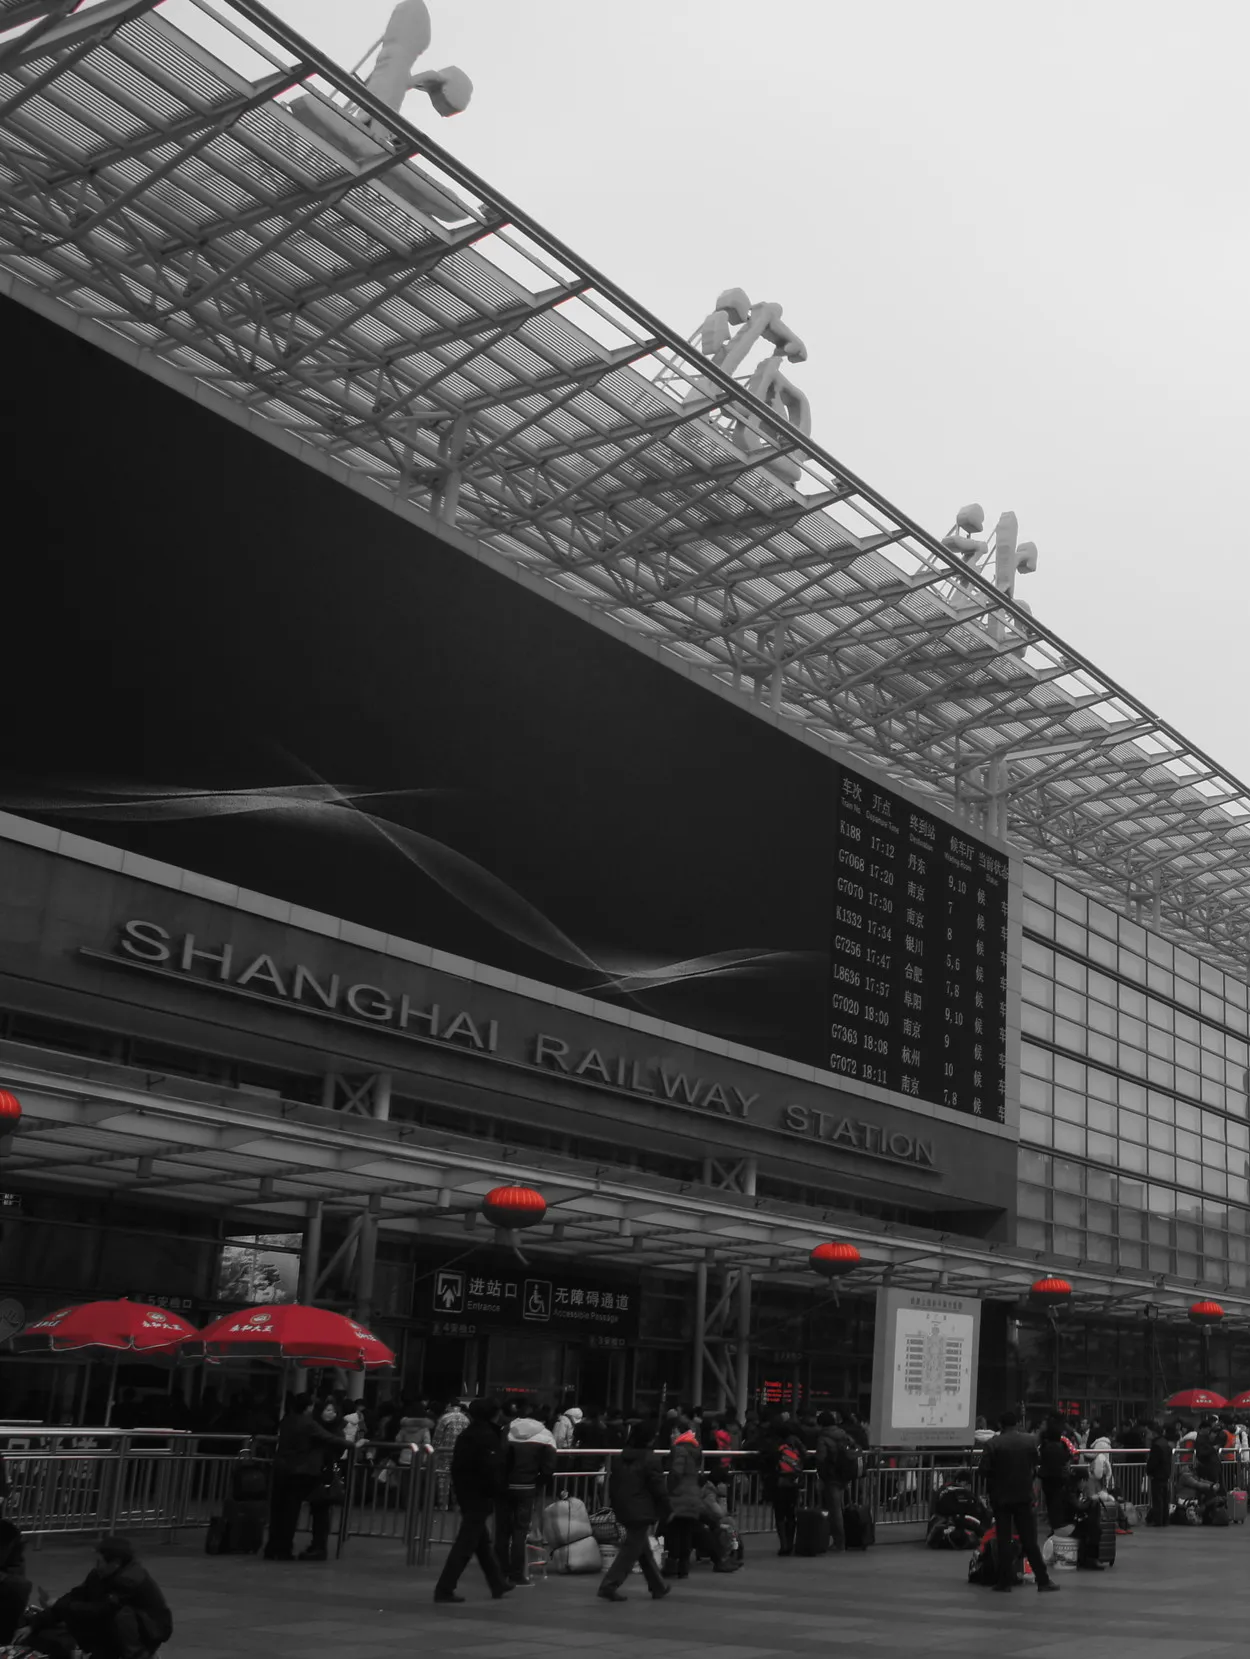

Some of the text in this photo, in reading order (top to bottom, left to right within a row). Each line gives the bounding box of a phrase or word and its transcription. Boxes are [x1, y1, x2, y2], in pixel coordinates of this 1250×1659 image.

[841, 777, 862, 801] 车次
[872, 793, 892, 817] 开点
[839, 819, 861, 842] K188
[871, 836, 895, 859] 17:12
[907, 853, 926, 875] 丹东
[838, 848, 865, 872] G7068
[869, 863, 894, 886] 17:20
[907, 880, 925, 902] 南京
[948, 901, 953, 914] 7
[836, 905, 862, 929] K1332
[867, 919, 892, 941] 17:34
[837, 877, 864, 900] G7070
[868, 891, 893, 914] 17:30
[906, 907, 924, 928] 南京
[947, 928, 952, 940] 8
[834, 935, 861, 958] G7256
[866, 948, 891, 969] 17:47
[833, 964, 860, 987] L8636
[865, 976, 890, 998] 17:57
[832, 993, 859, 1016] G7020
[864, 1005, 889, 1026] 18:00
[903, 1018, 921, 1039] 南京
[944, 1034, 950, 1048] 9
[121, 919, 937, 1164] SHANGHAI RAILWAY STATION
[831, 1023, 858, 1045] G7363
[863, 1034, 888, 1055] 18:08
[901, 1045, 920, 1067] 杭州
[944, 1062, 954, 1077] 10
[830, 1053, 857, 1074] G7072
[862, 1064, 887, 1084] 18:11
[901, 1074, 920, 1095] 南京
[467, 1301, 501, 1312] Entrance
[468, 1277, 518, 1298] 进站口
[555, 1287, 630, 1311] 无障碍通道
[552, 1308, 619, 1323] Accessible Passage
